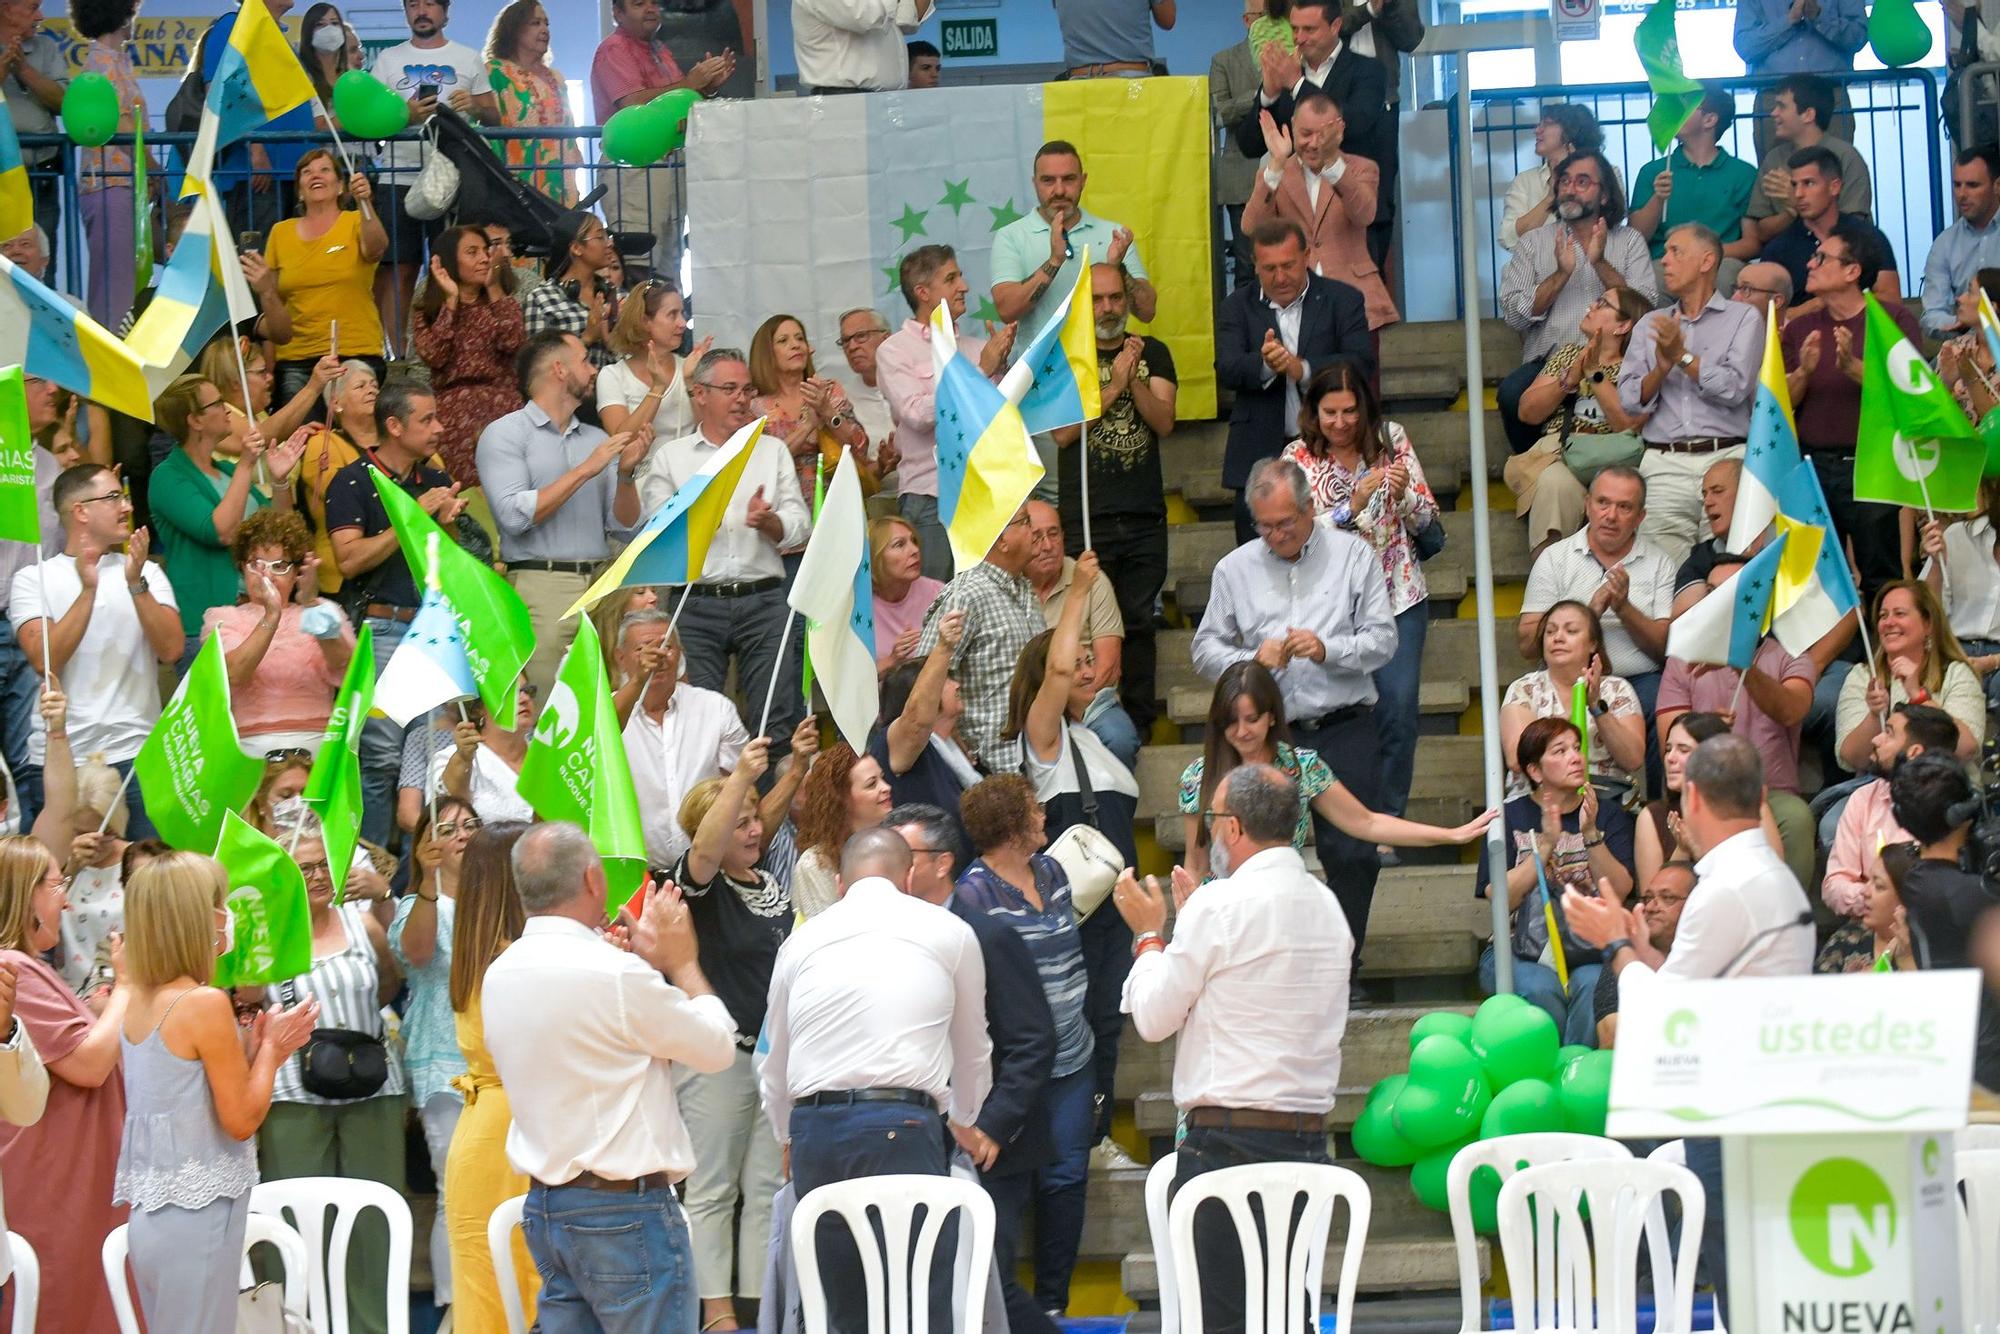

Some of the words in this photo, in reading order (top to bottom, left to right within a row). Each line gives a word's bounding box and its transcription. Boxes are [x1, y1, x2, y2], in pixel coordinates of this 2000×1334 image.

[133, 20, 167, 40] lub
[173, 20, 196, 40] de
[945, 26, 994, 51] SALIDA
[181, 703, 205, 775] NUEVA
[170, 719, 211, 817] CANARIAS
[558, 764, 588, 809] BLOQUE
[1759, 1009, 1938, 1054] ustedes
[1781, 1302, 1915, 1333] NUEVA
